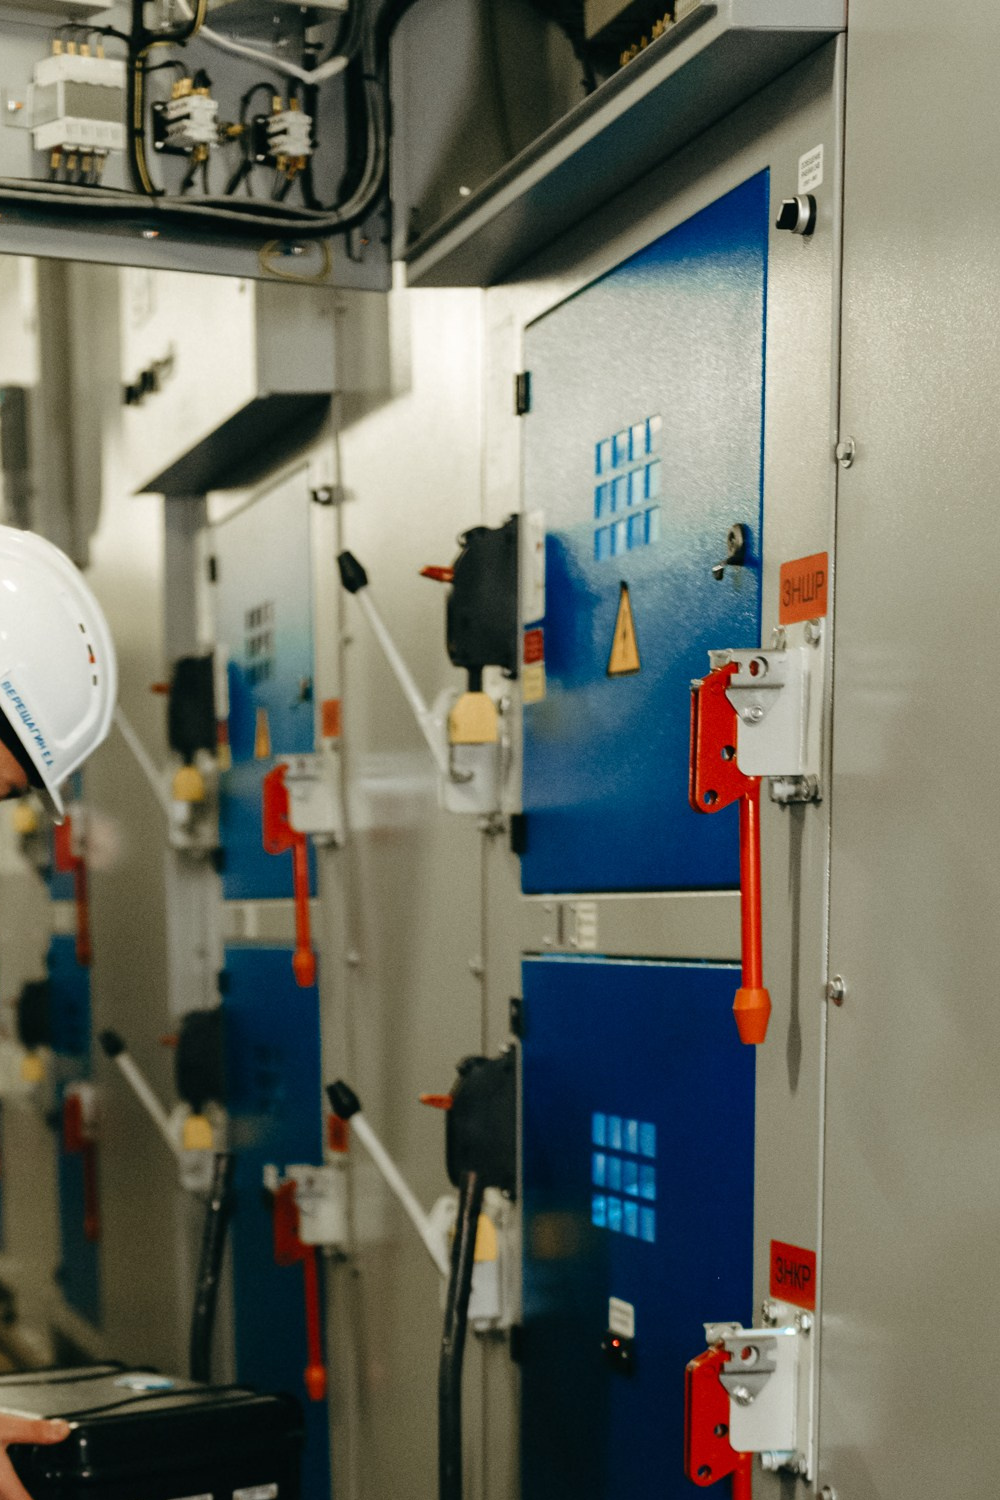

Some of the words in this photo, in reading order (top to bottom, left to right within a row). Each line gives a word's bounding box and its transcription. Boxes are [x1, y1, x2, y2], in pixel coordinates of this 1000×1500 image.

[782, 570, 825, 608] ЗНШР
[1, 681, 47, 750] ВЕРЕЩАГИН
[775, 1256, 811, 1291] ЗНКР
